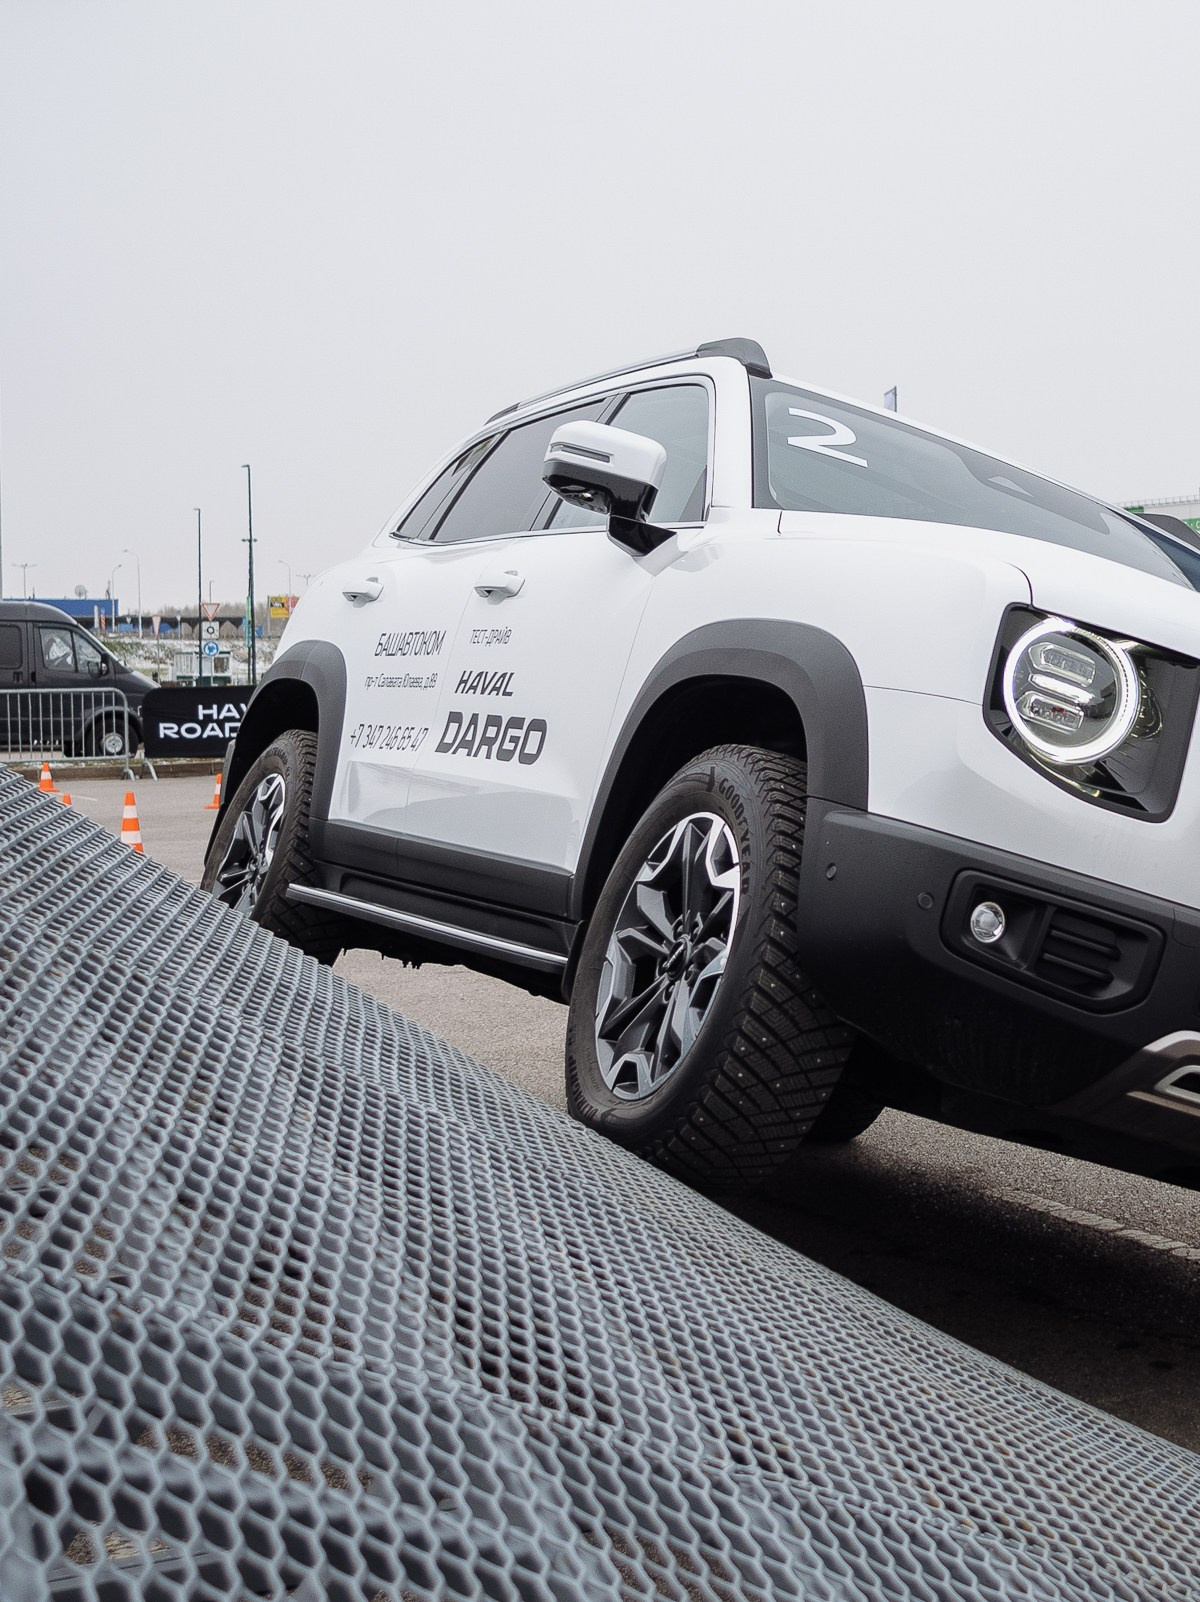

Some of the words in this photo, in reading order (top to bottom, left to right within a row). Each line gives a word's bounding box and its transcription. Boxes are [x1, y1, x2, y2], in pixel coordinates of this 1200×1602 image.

[787, 407, 869, 469] 2
[374, 630, 447, 657] БАШАВТОКОМ
[470, 626, 512, 647] ТЕСТ-ДРАЙВ
[454, 670, 515, 697] HAVAL
[350, 723, 365, 748] +7
[362, 724, 384, 749] 347
[379, 725, 402, 750] 246
[397, 726, 415, 751] 65
[410, 727, 429, 752] 47
[434, 710, 548, 766] DARGO
